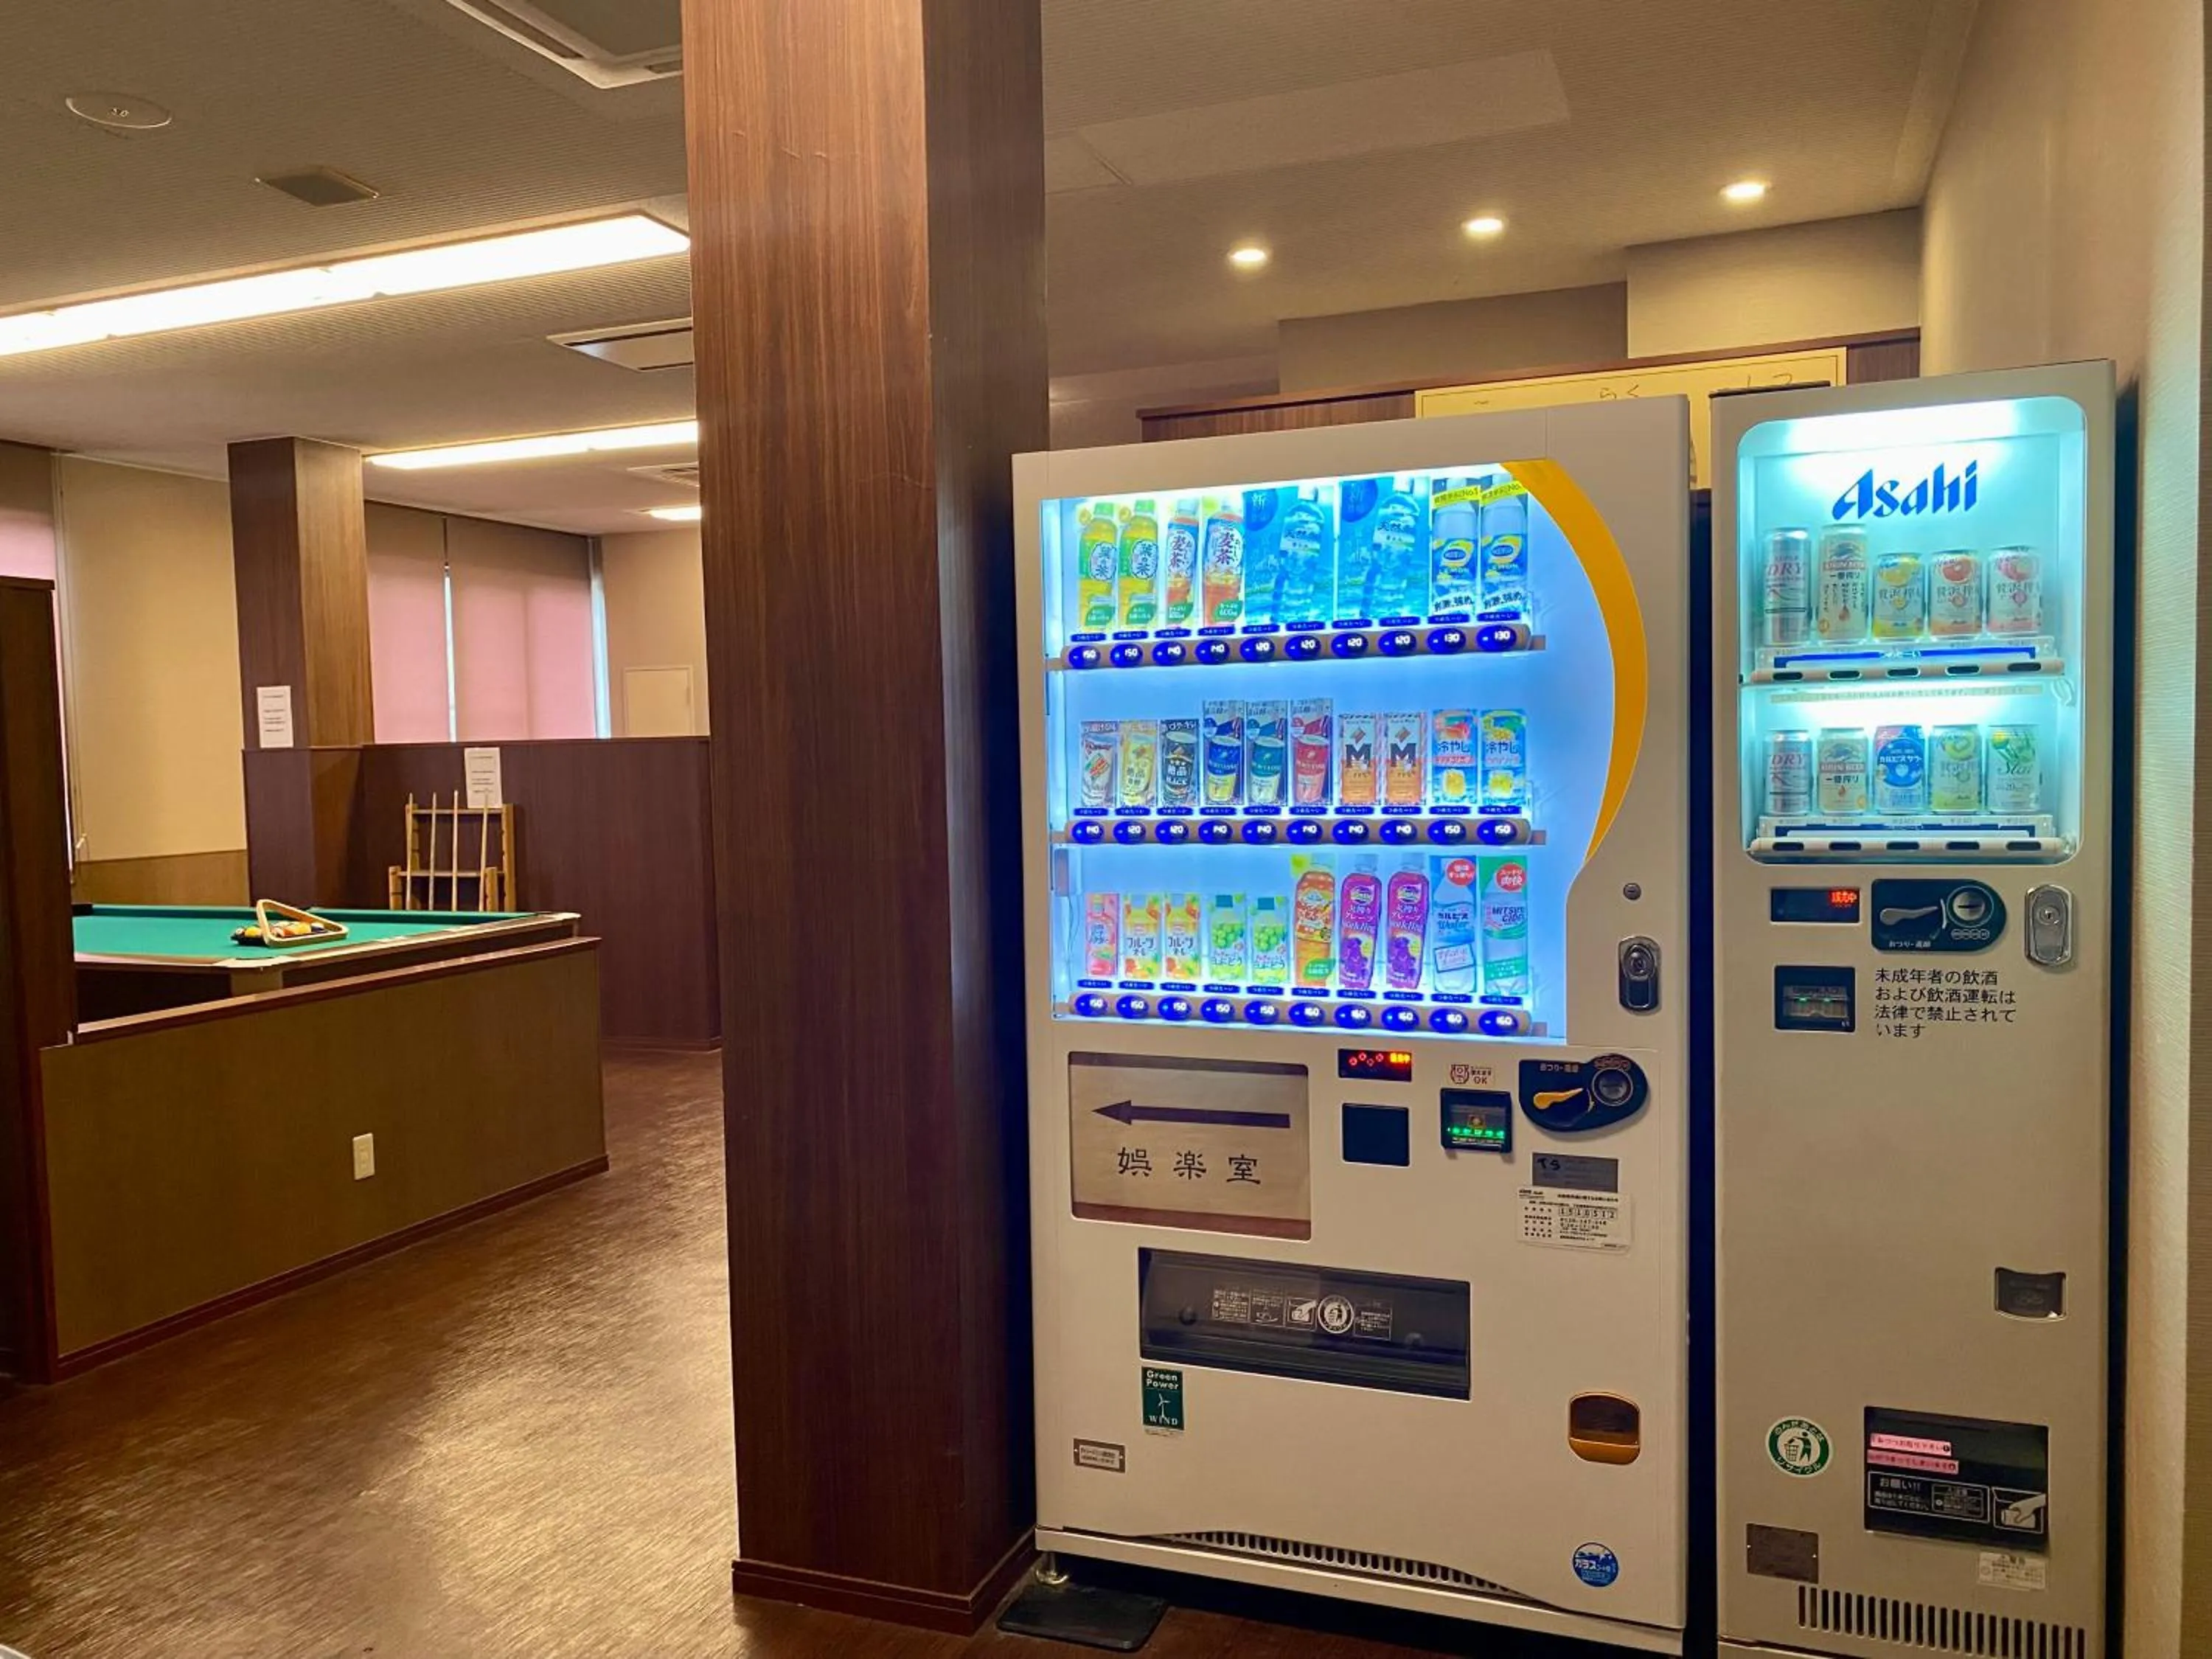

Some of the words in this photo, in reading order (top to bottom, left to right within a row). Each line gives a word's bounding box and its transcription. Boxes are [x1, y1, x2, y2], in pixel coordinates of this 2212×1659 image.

[1832, 459, 1978, 521] Asahi
[1169, 535, 1186, 568] 麦茶
[1215, 531, 1234, 566] 麦茶
[1767, 561, 1804, 576] DRY
[1444, 633, 1459, 641] 130
[1495, 631, 1510, 639] 130
[1439, 740, 1470, 754] 冷やし
[1486, 740, 1519, 754] 冷やし
[1345, 742, 1372, 768] M
[1390, 742, 1417, 768] M
[1772, 754, 1804, 765] DRY
[1826, 775, 1859, 784] 一番搾り
[1127, 936, 1155, 949] フルーツ
[1167, 936, 1194, 949] フルーツ
[1875, 967, 1999, 986] 未成年者の飲酒
[1875, 987, 2017, 1004] および飲酒運転は
[1875, 1005, 2017, 1023] 法律で禁止されて
[1877, 1023, 1926, 1039] います
[1474, 1076, 1488, 1085] OK
[1116, 1147, 1261, 1185] 娯楽室
[1147, 1370, 1178, 1382] Green
[1146, 1378, 1179, 1390] Power
[1149, 1415, 1178, 1425] WIND
